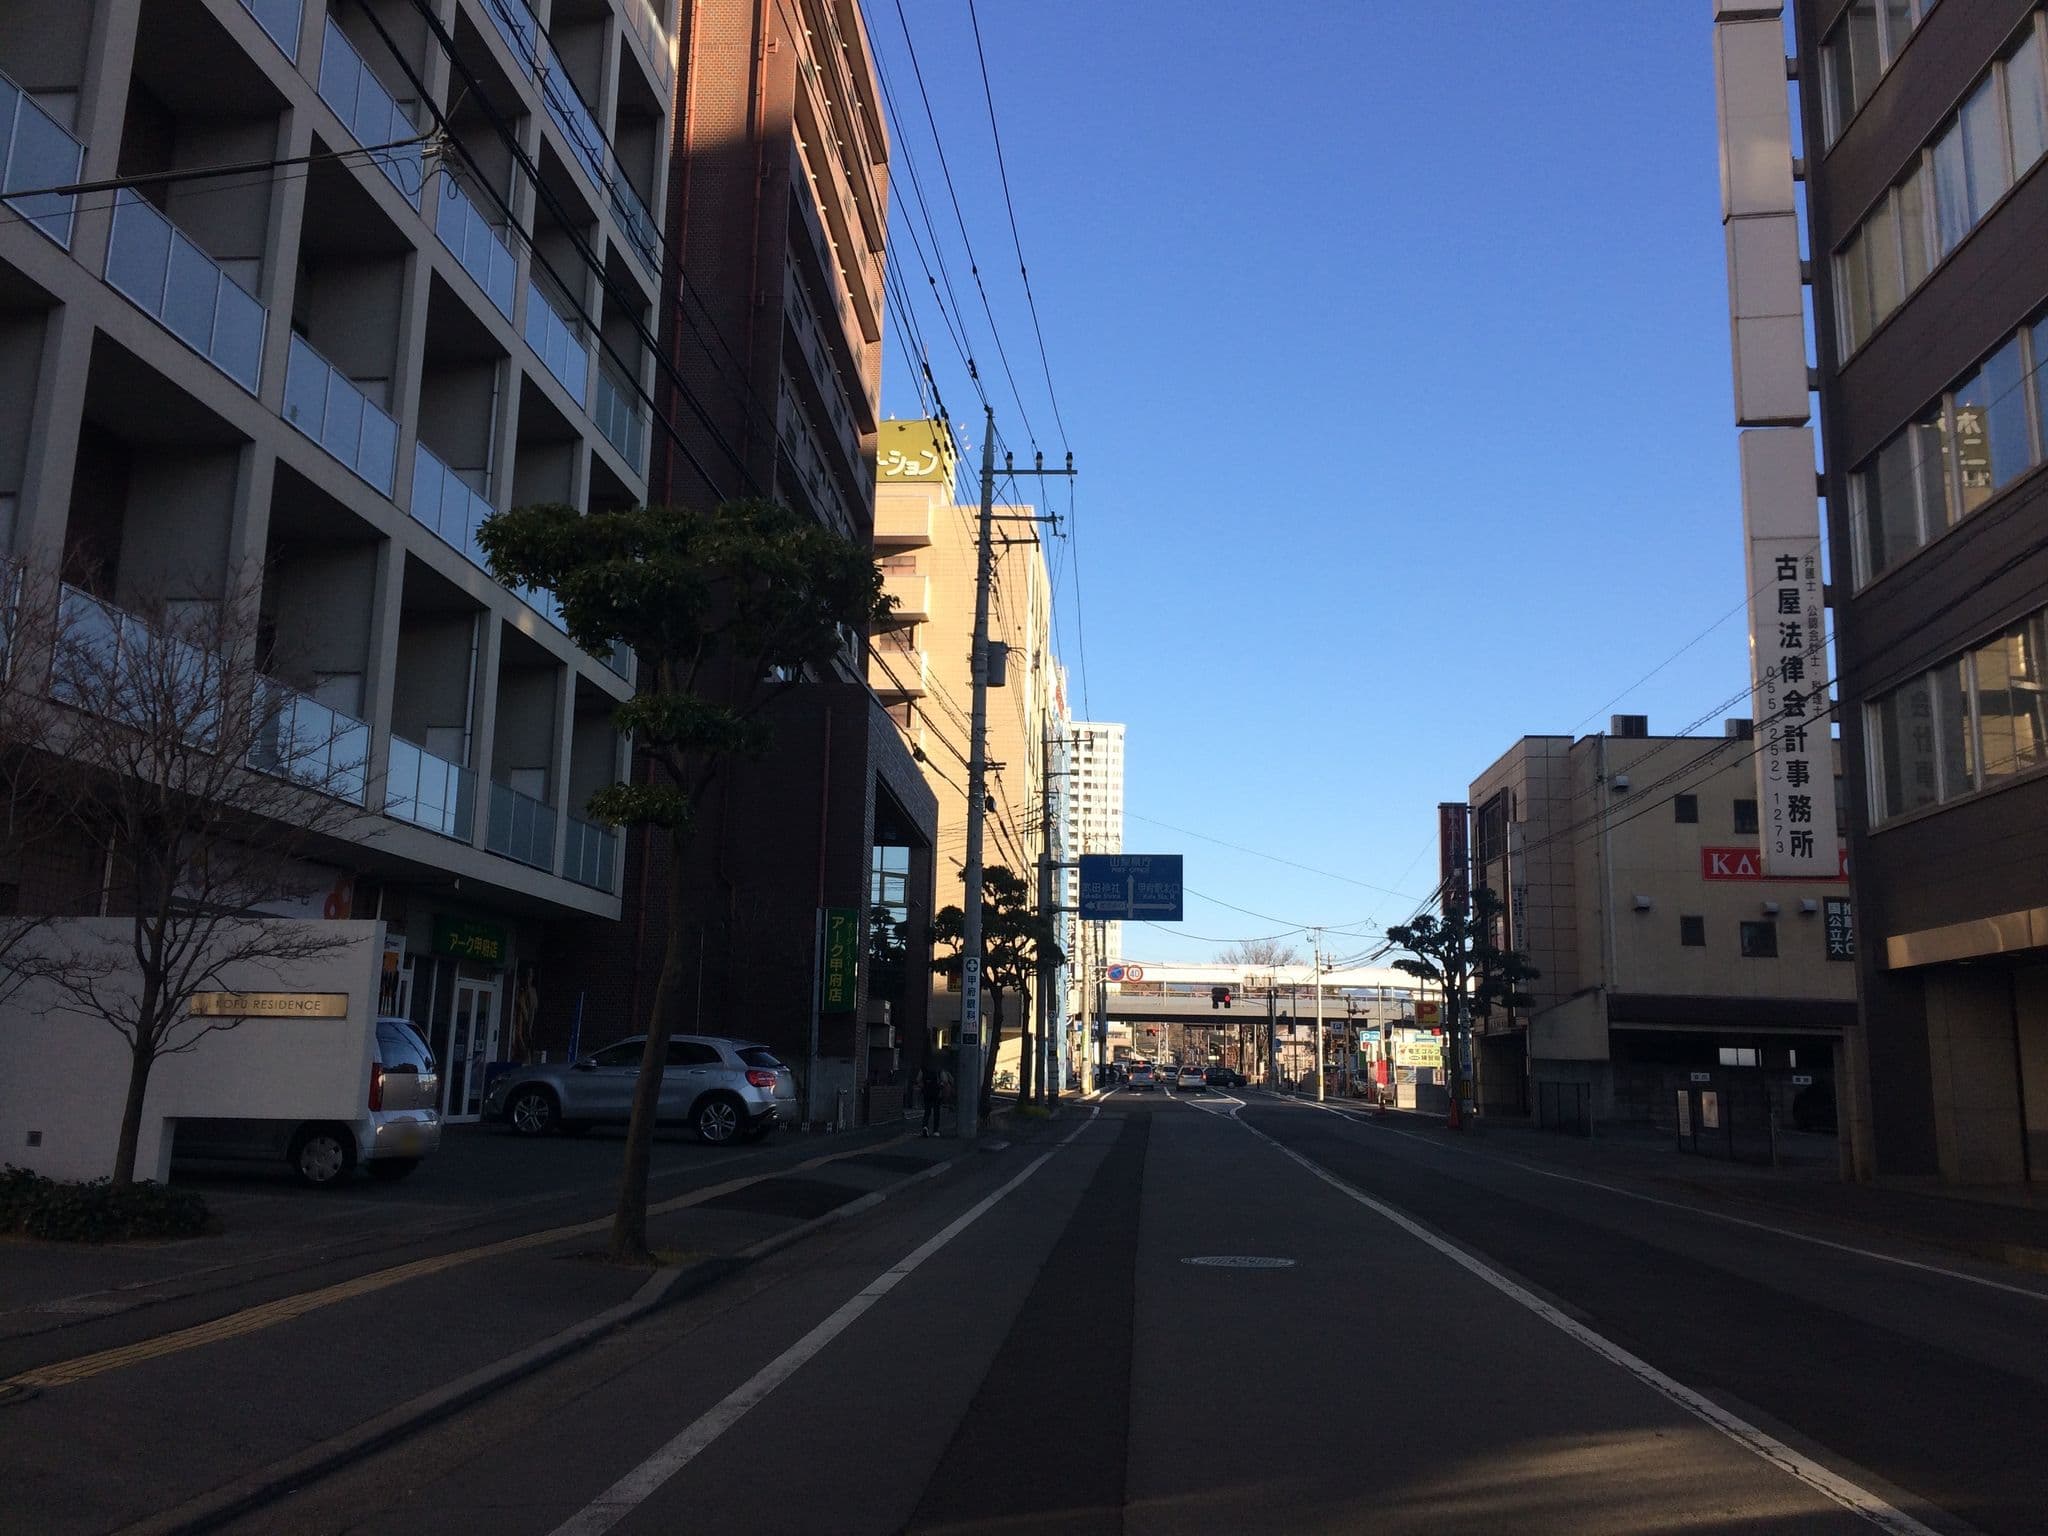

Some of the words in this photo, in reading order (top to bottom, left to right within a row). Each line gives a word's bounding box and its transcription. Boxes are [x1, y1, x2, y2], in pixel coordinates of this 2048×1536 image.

[1775, 554, 1813, 858] 古屋法律会計事務所
[829, 916, 845, 1002] アーク甲府店
[1130, 968, 1140, 978] 40
[253, 999, 321, 1011] RESIDENCE
